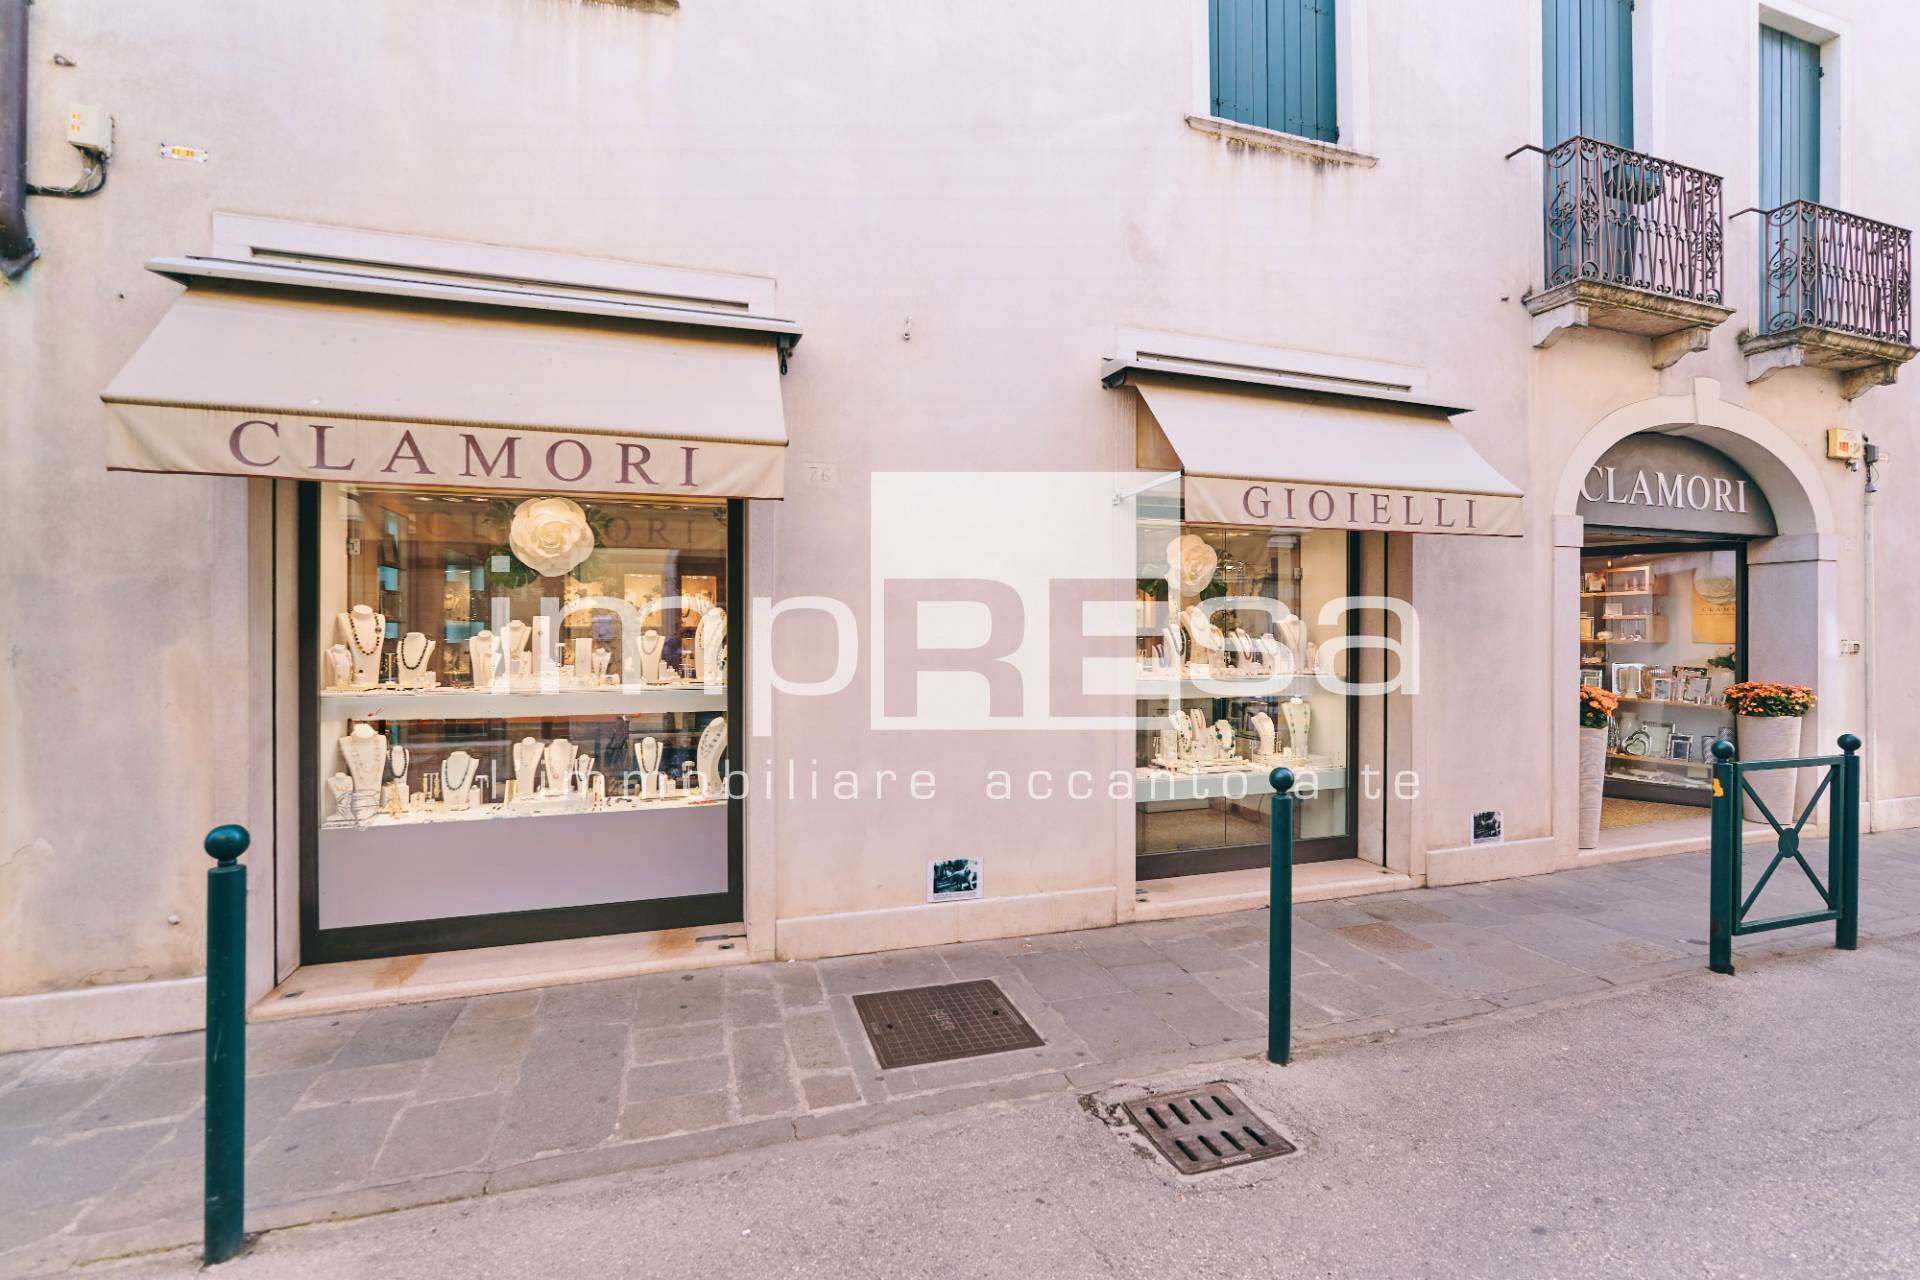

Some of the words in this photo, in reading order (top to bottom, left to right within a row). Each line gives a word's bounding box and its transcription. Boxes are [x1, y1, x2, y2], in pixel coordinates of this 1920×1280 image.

[228, 420, 700, 487] CLAMORI
[1242, 485, 1477, 529] GIOIELLI
[1580, 465, 1748, 514] CLAMORI
